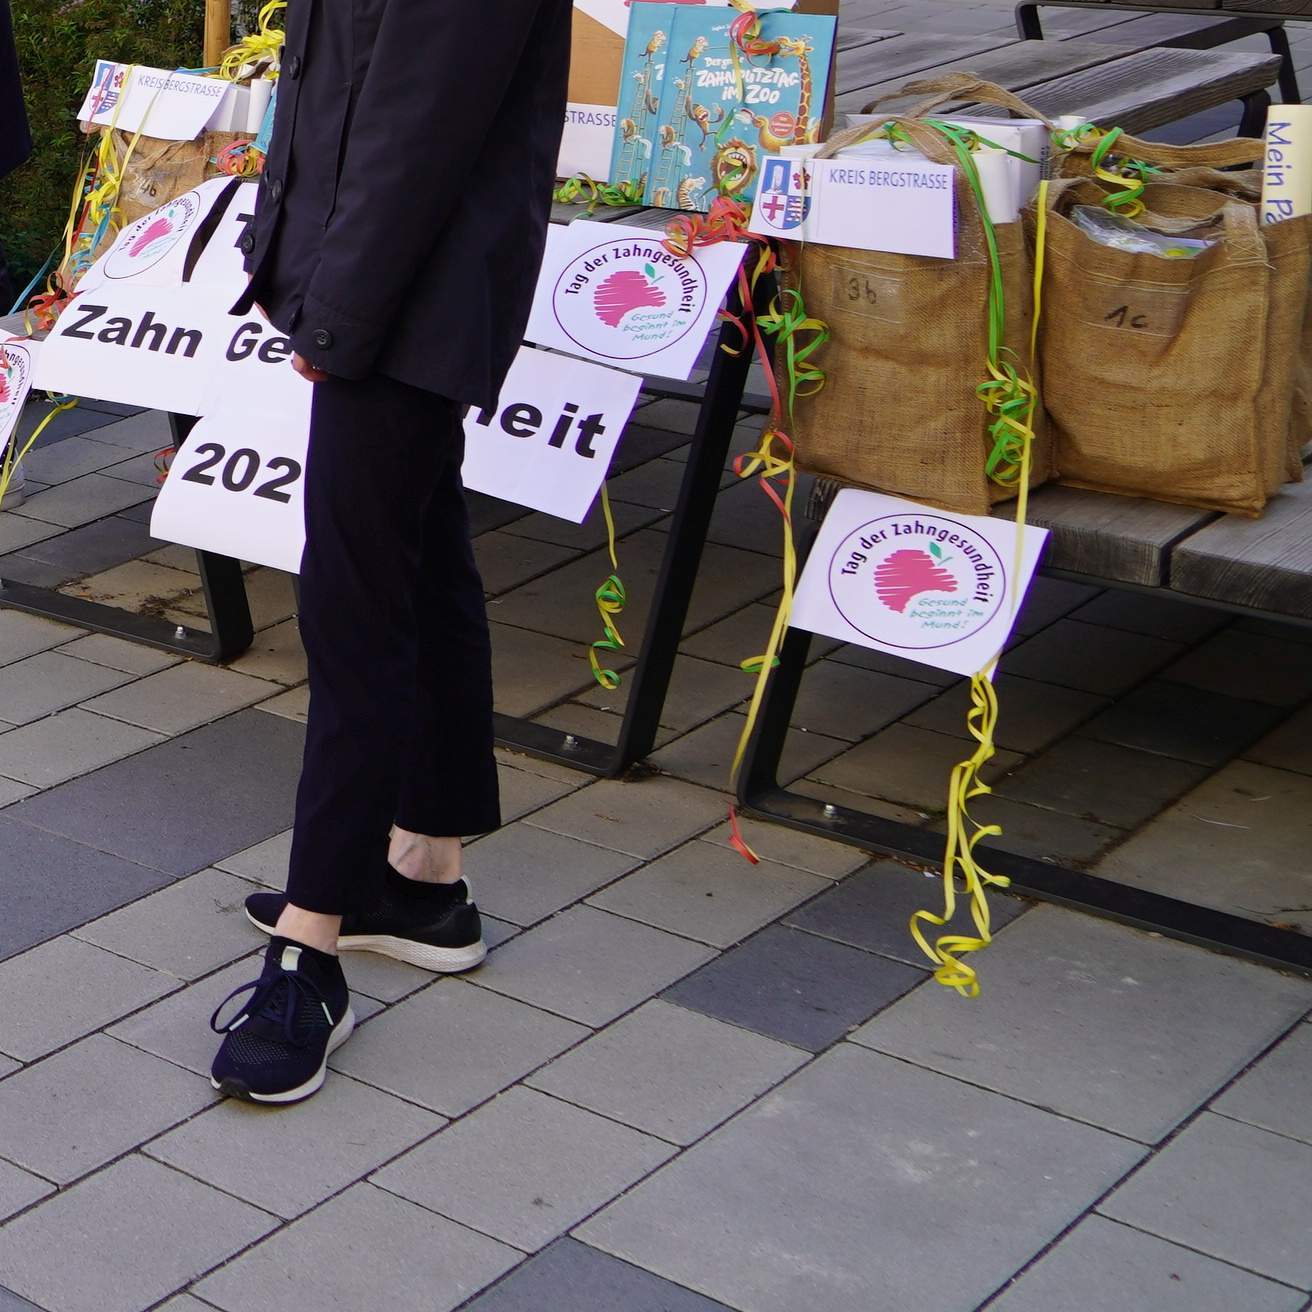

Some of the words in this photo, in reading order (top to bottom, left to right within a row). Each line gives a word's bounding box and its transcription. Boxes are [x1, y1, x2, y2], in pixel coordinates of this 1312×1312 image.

[137, 75, 163, 89] KREIS
[163, 78, 223, 97] BERGSTRASSE
[829, 169, 865, 185] KREIS
[869, 170, 949, 190] BERGSTRASSE
[1267, 122, 1293, 187] Mein
[565, 273, 590, 295] Tag
[584, 254, 609, 273] der
[612, 244, 698, 313] Zahngesundheit
[60, 304, 203, 358] Zahn
[181, 442, 302, 504] 202
[841, 550, 868, 576] Tag
[859, 528, 888, 550] der
[891, 520, 995, 603] Zahngesundheit
